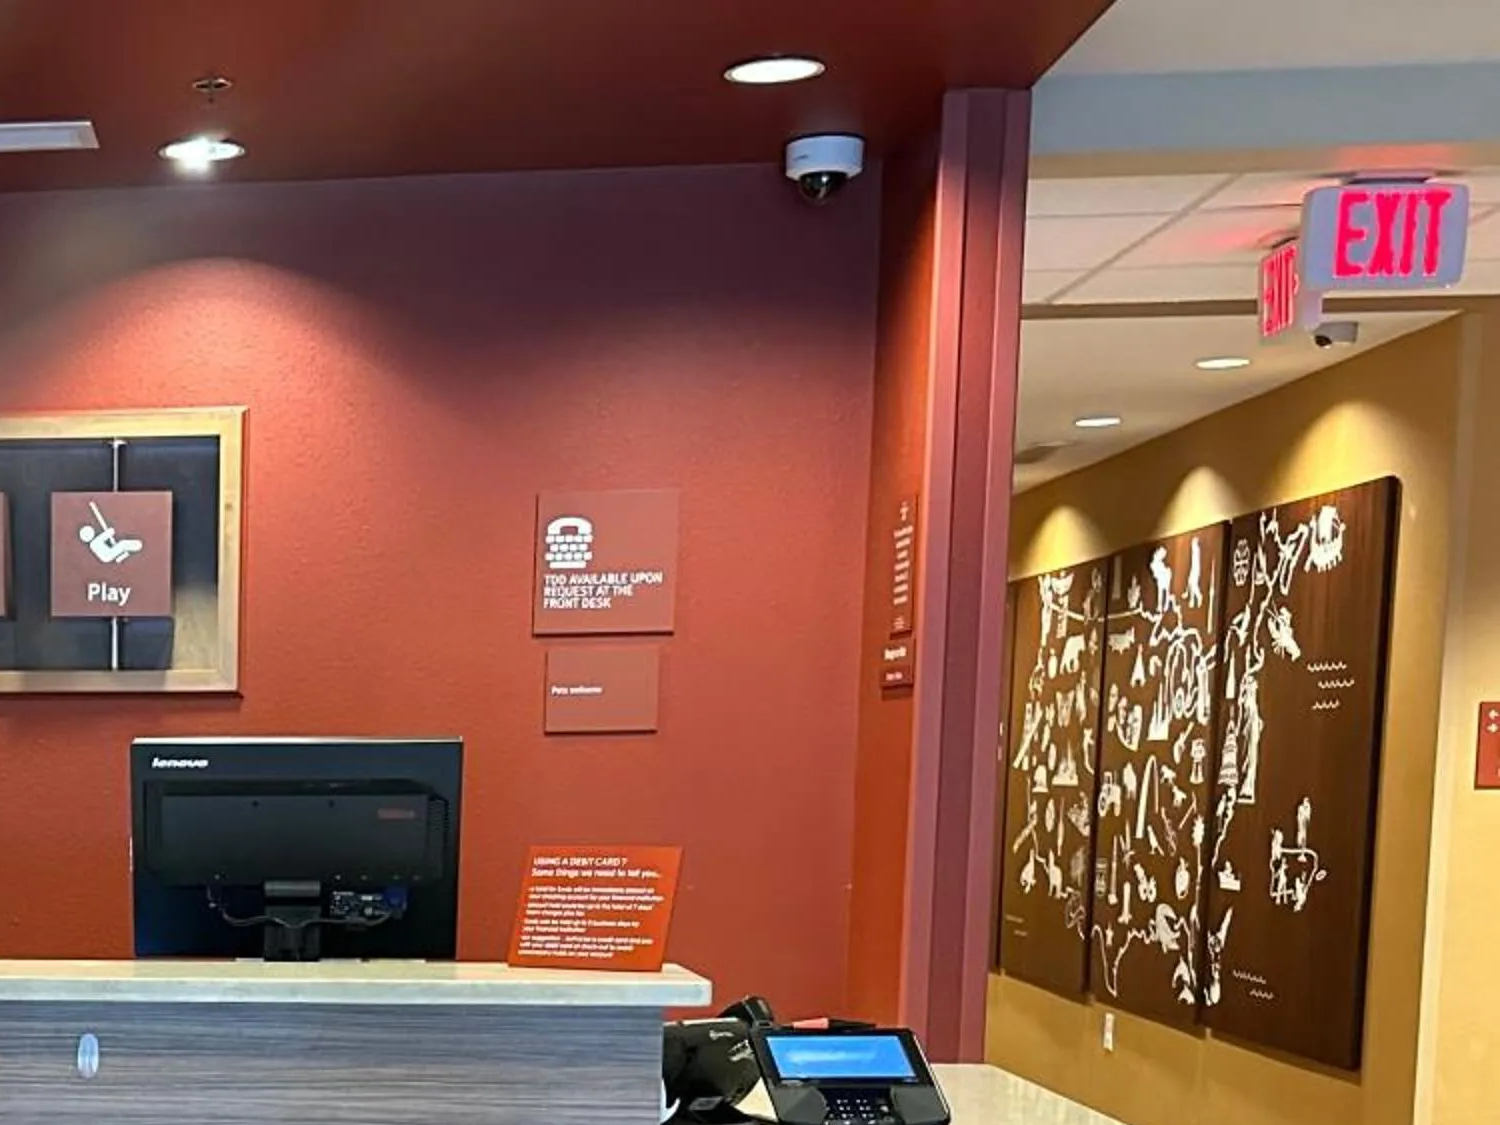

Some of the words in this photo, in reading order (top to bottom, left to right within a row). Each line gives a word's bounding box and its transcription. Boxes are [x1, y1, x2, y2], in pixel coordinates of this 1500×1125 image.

[1333, 189, 1453, 278] EXIT
[1263, 245, 1297, 337] EXIT
[569, 572, 628, 585] AVAILABLE
[630, 571, 663, 584] UPON
[87, 583, 132, 606] Play
[543, 585, 593, 598] REQUEST
[595, 585, 609, 597] AT
[612, 584, 634, 596] THE
[543, 597, 581, 609] FRONT
[581, 597, 612, 609] DESK
[151, 757, 209, 768] lenovo
